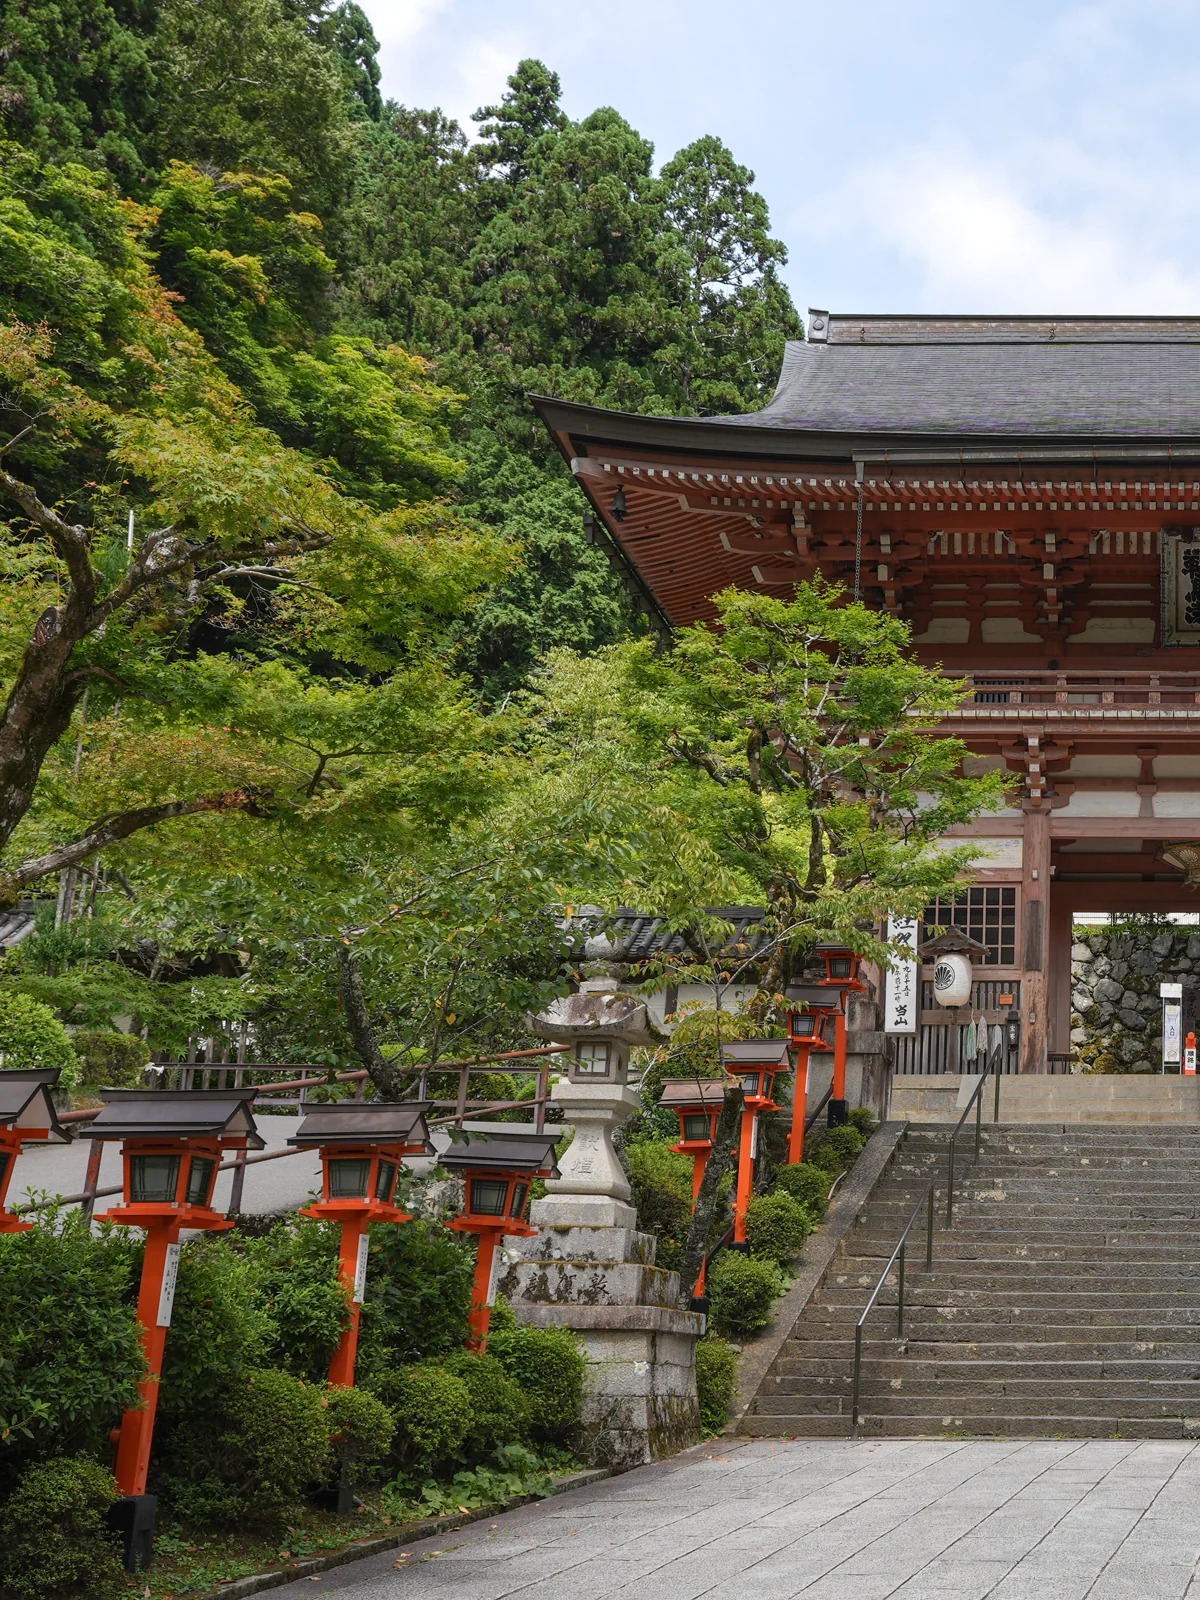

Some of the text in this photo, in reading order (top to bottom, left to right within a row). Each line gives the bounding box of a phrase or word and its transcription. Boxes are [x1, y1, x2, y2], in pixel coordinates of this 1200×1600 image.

[894, 1004, 908, 1026] 当山
[1170, 1025, 1175, 1036] 入口
[1187, 1050, 1194, 1064] 順路
